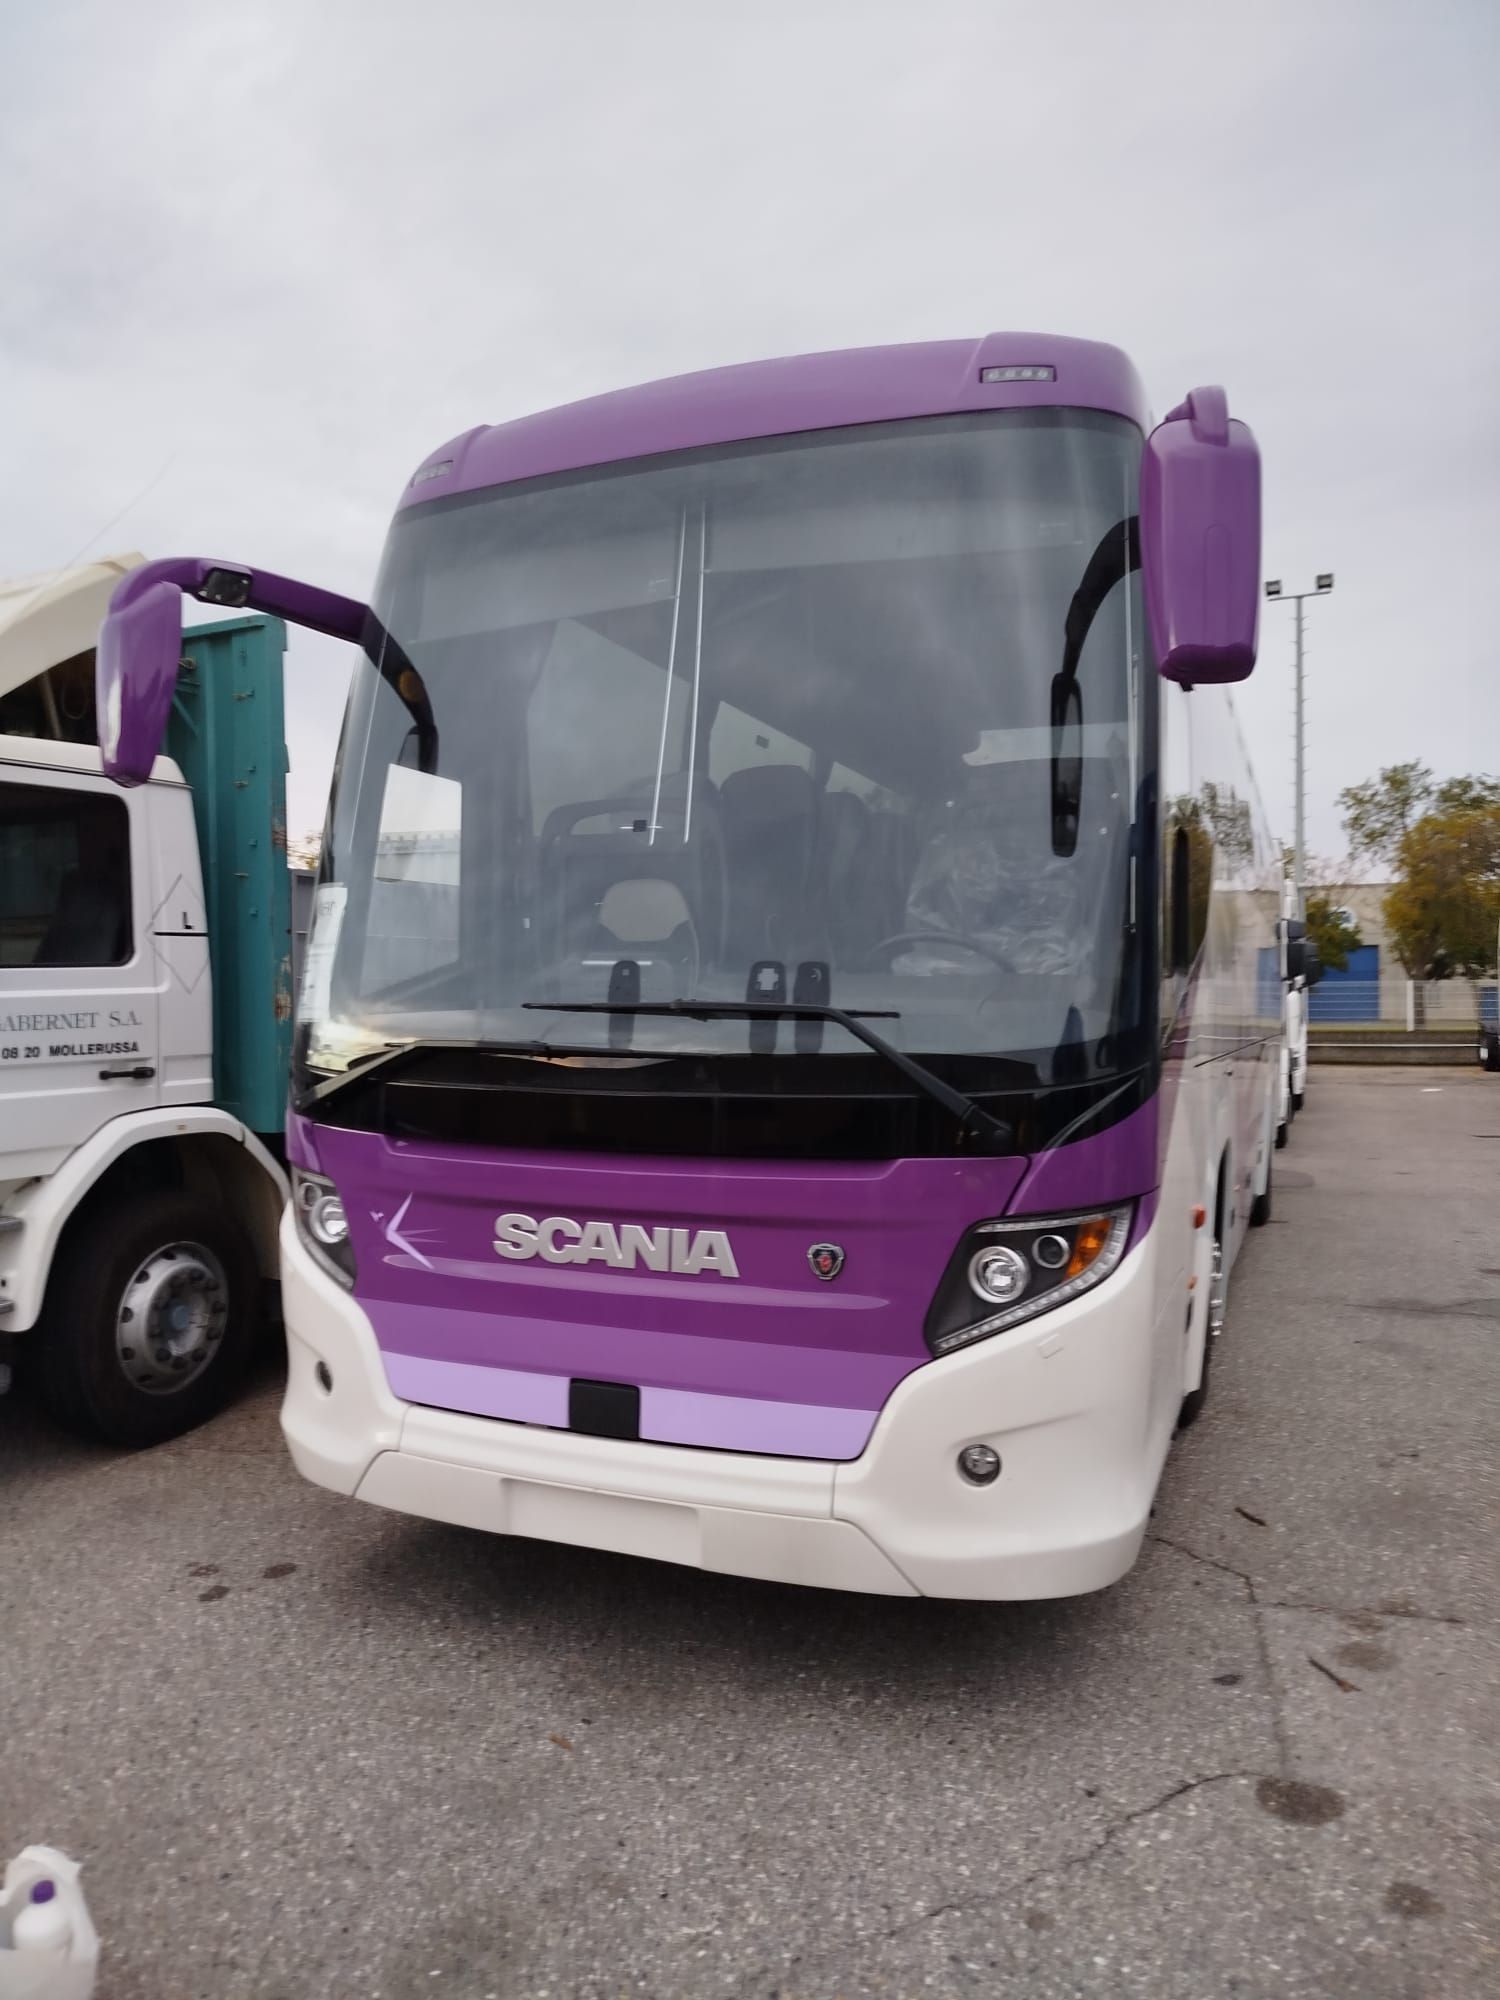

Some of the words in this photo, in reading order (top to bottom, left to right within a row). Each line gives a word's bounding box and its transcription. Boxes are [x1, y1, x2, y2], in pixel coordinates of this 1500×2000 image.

[0, 1012, 100, 1032] ABERNET
[24, 1046, 41, 1058] 20
[49, 1041, 139, 1056] MOLLERUSSA
[493, 1213, 740, 1278] SCANIA
